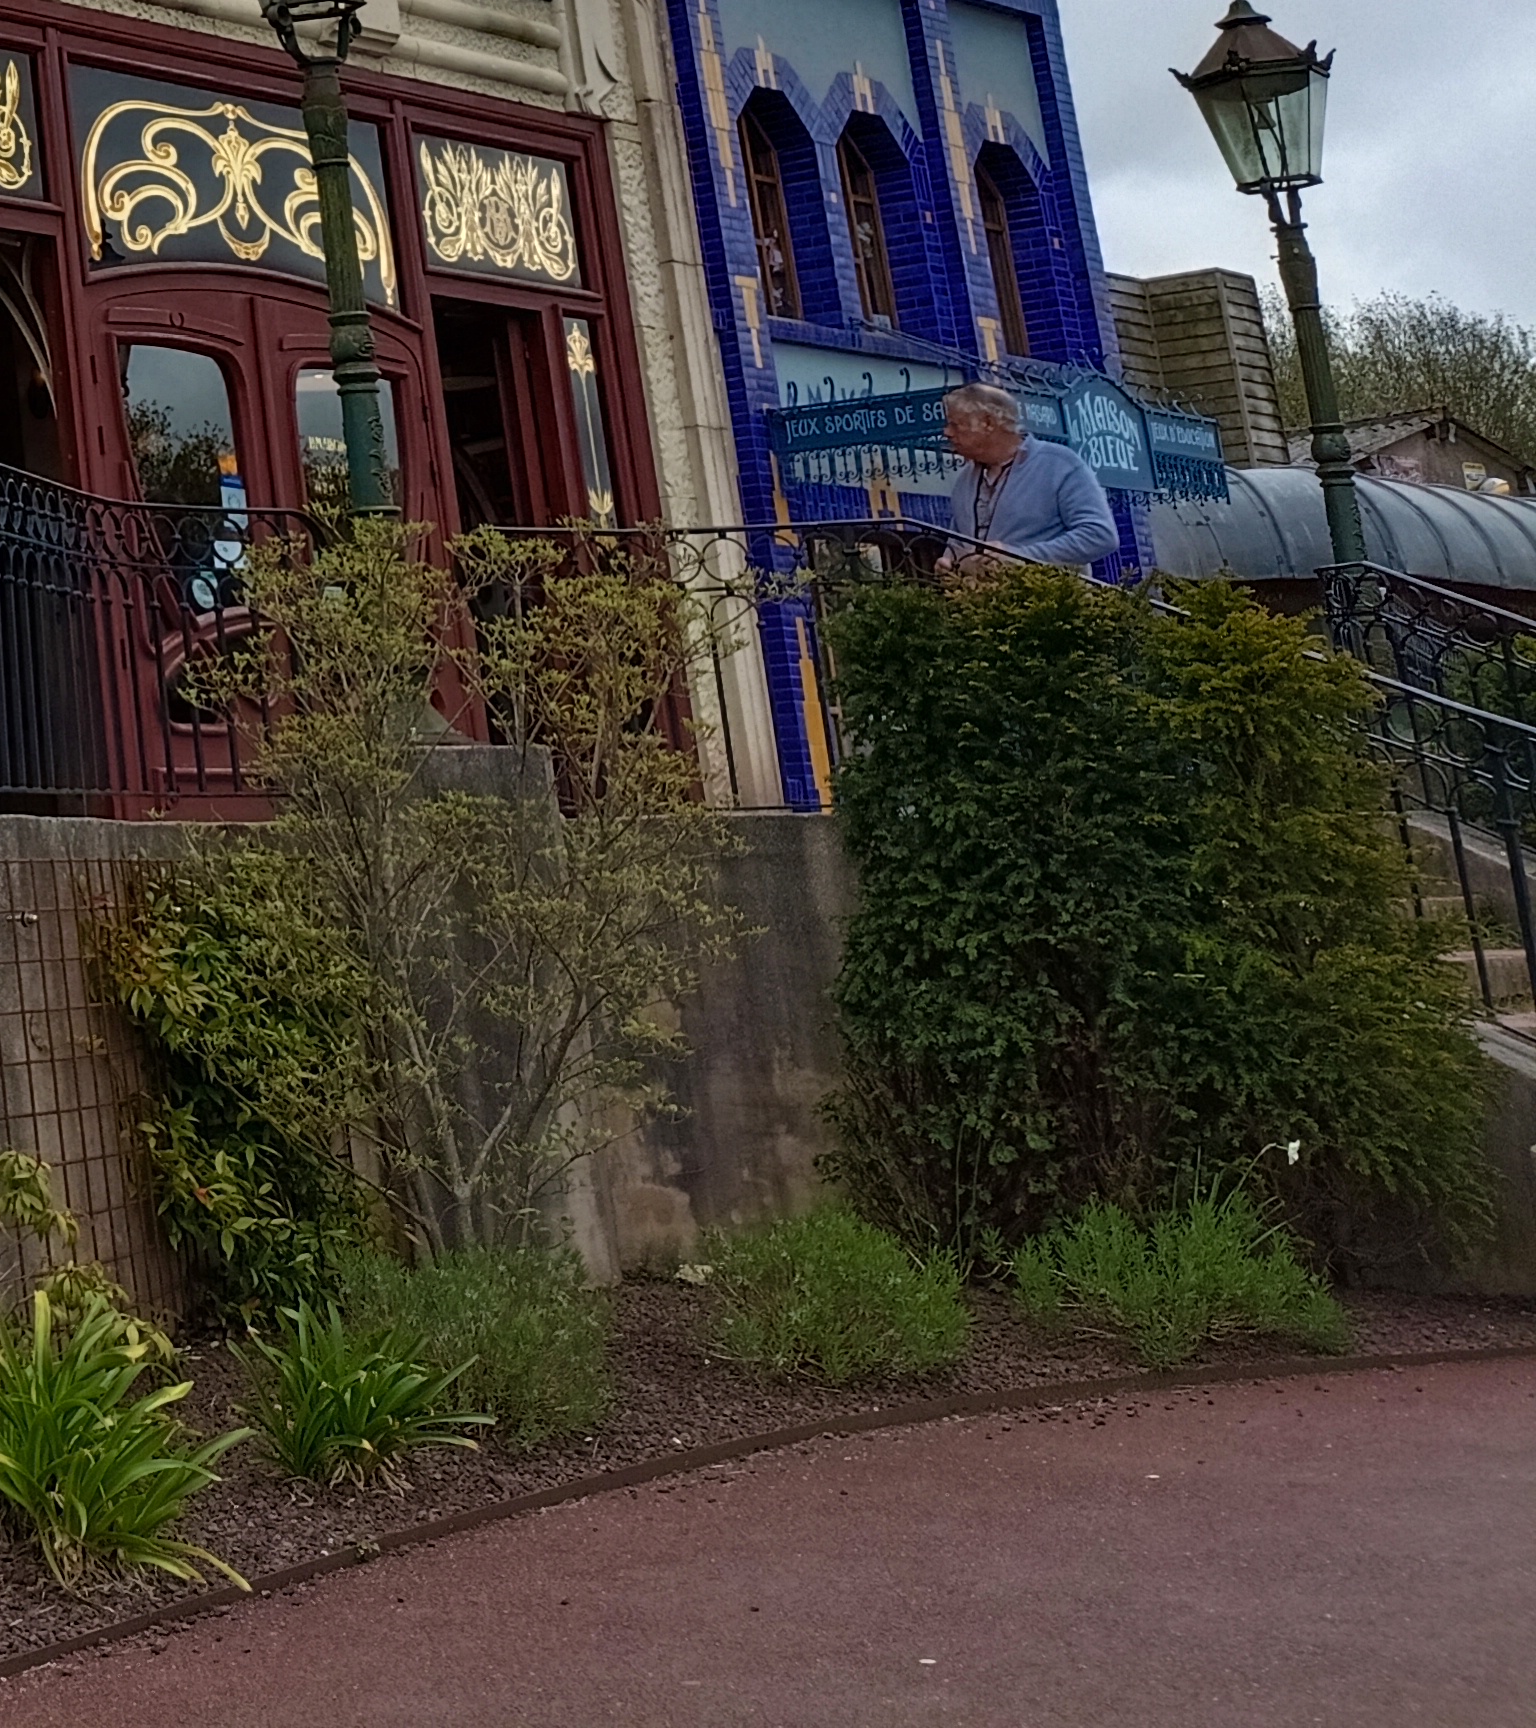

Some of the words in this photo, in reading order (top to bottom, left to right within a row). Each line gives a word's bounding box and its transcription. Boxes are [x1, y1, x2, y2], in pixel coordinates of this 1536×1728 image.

[786, 416, 821, 445] JEUX
[825, 407, 888, 436] SPORTIFS
[895, 404, 917, 426] DE
[922, 400, 949, 423] SA
[1075, 390, 1142, 452] MAISON
[1080, 433, 1140, 472] BLEUE
